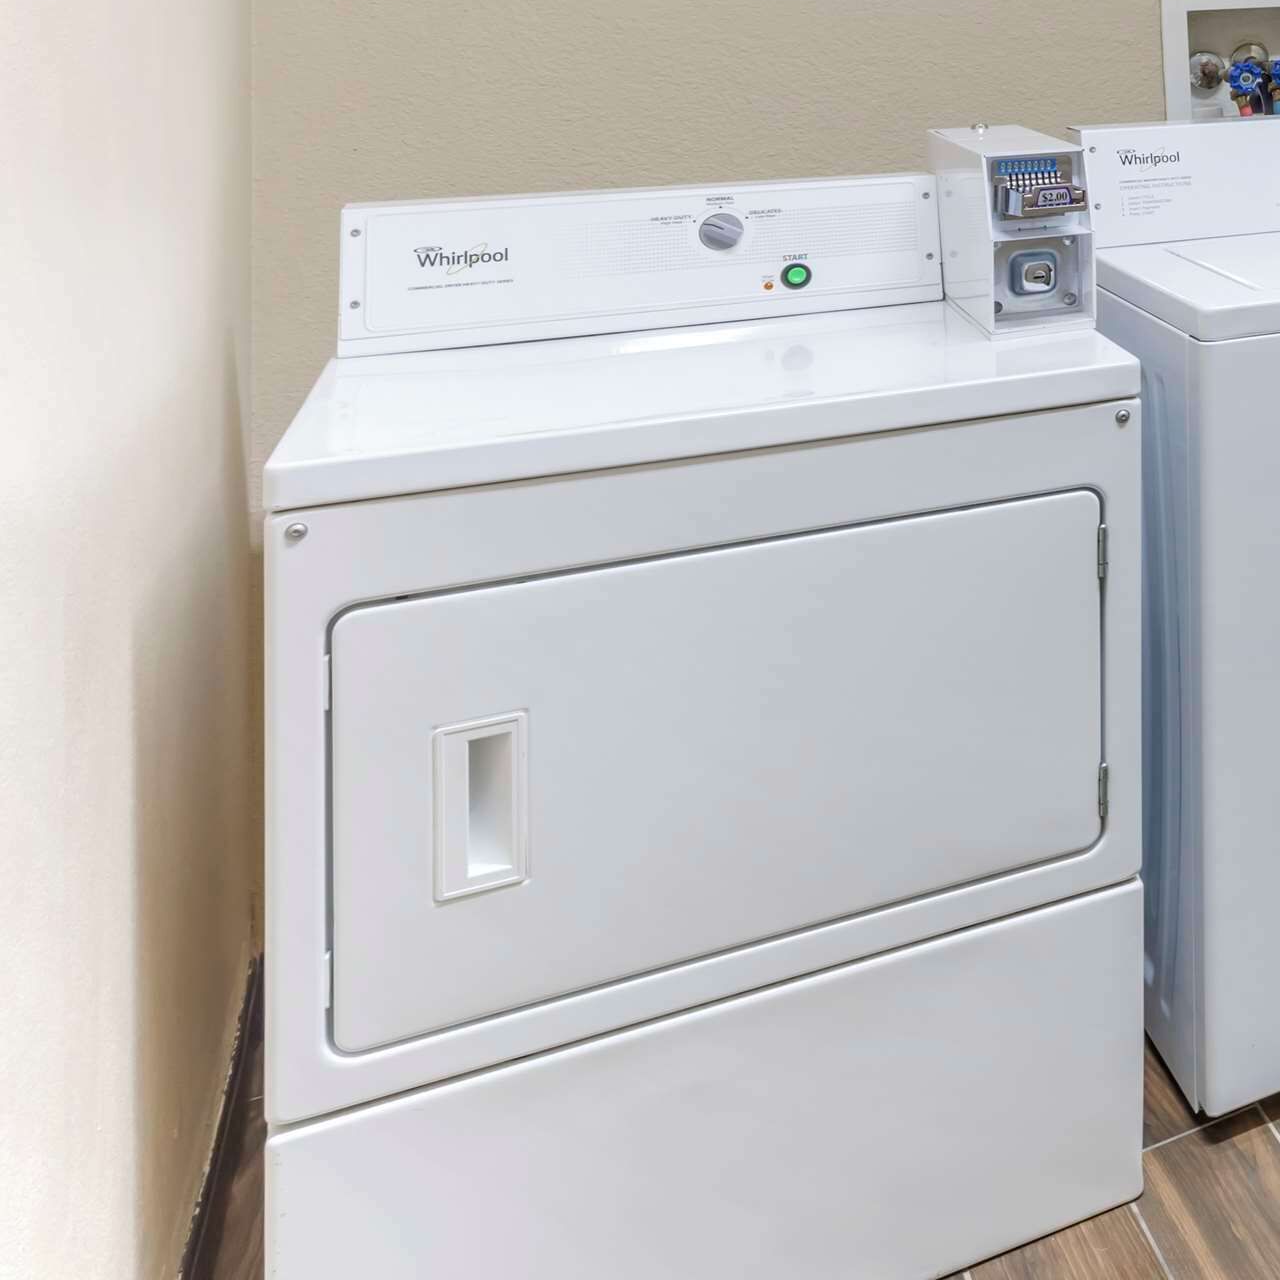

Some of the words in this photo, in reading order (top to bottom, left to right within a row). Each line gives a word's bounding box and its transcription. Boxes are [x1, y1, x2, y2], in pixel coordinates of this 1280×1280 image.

[1119, 151, 1181, 167] Whirlpool
[1041, 191, 1068, 203] $2.00
[417, 247, 509, 268] Whirlpool
[782, 253, 808, 262] START
